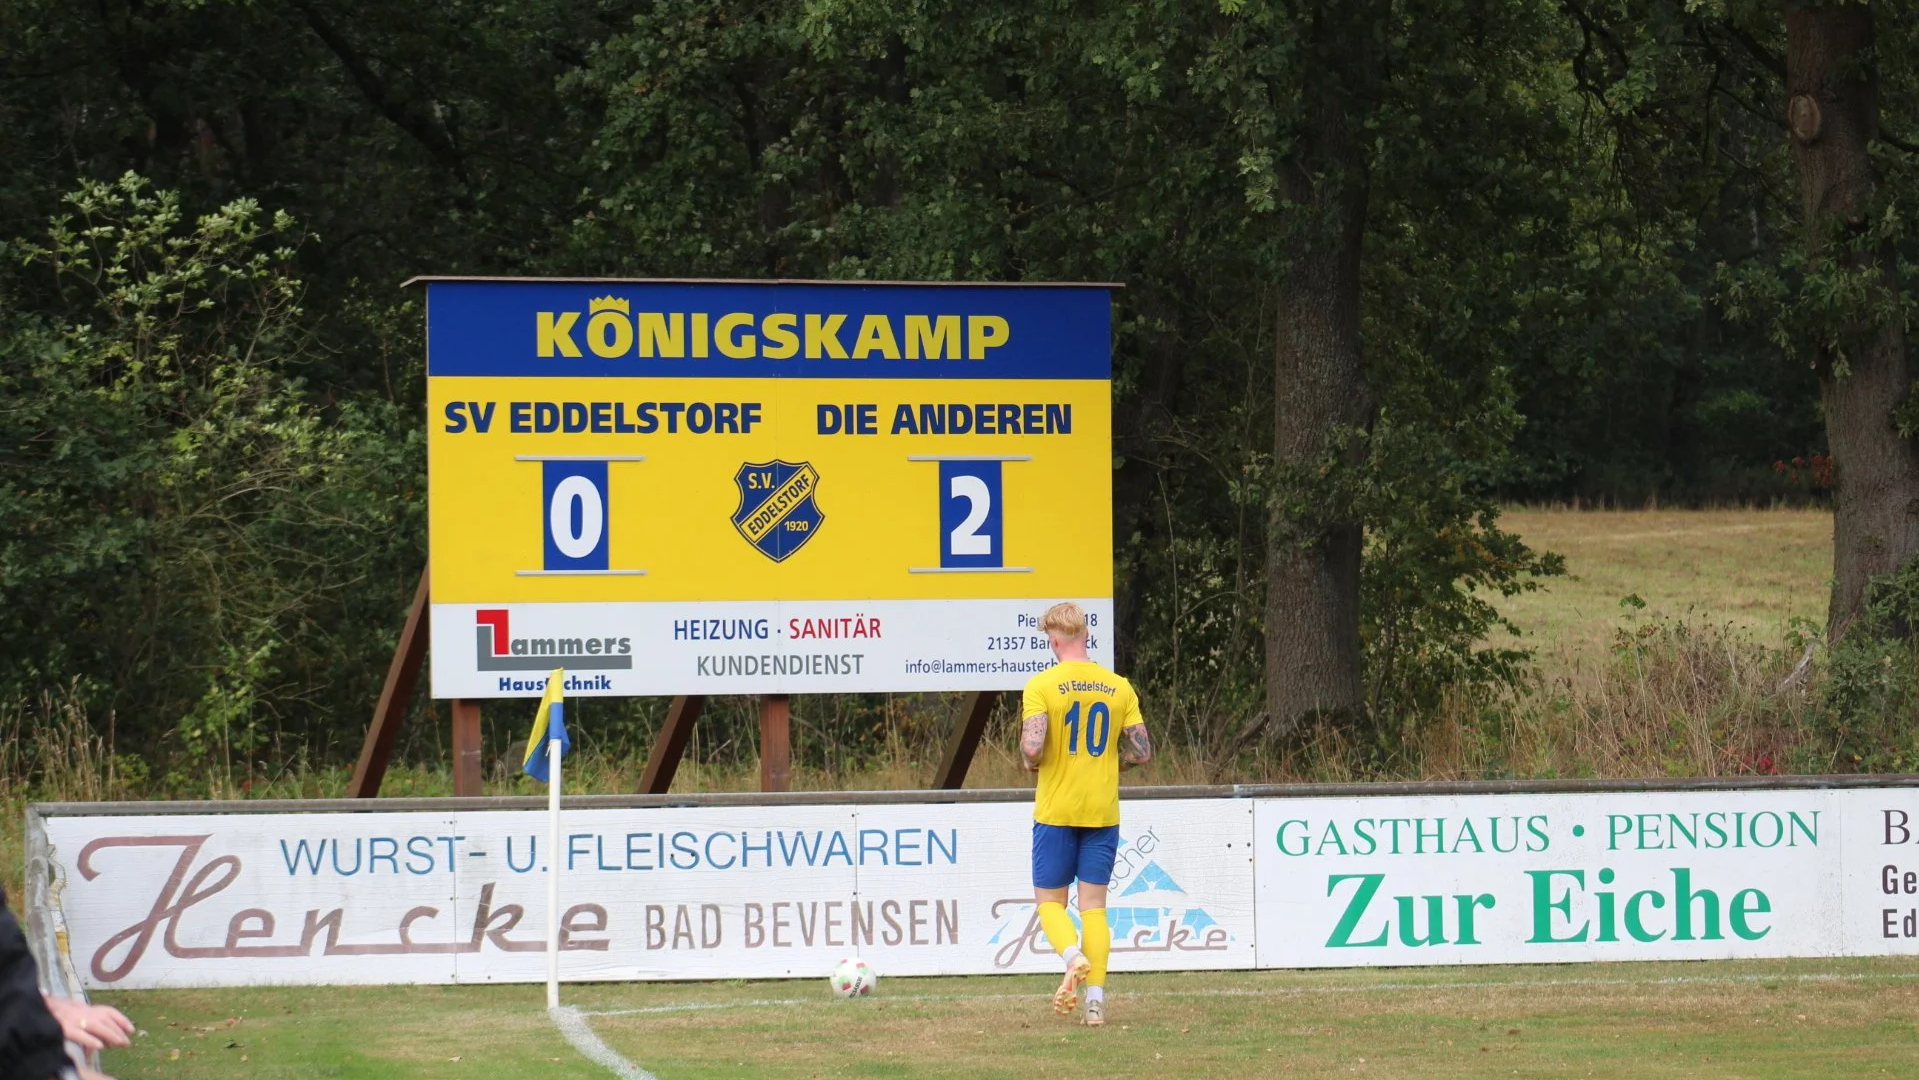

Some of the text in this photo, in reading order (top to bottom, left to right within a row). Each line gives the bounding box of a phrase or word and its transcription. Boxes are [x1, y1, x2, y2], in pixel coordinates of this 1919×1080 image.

[445, 402, 762, 434] SV EDDELSTORF
[817, 404, 1072, 435] DIE ANDEREN
[748, 472, 775, 489] S.V.
[550, 475, 603, 559] 0
[747, 474, 810, 535] EDDELSTORF
[950, 475, 991, 555] 2
[784, 521, 809, 532] 1920
[674, 613, 882, 640] HEIZUNG SANITÄR
[987, 637, 1026, 650] 21357
[499, 675, 612, 691] Hauschnik
[697, 654, 865, 676] KUNDENDIENST
[1058, 680, 1116, 697] SV Eddelstorf
[1064, 700, 1110, 757] 10
[1276, 810, 1821, 857] GASTHAUS PENSION
[1880, 809, 1919, 845] B
[279, 828, 957, 876] WURST- U. FLEISCHWAREN
[76, 833, 610, 982] Hencke
[645, 899, 959, 950] BAD BEVENSEN
[1325, 867, 1772, 948] Zur Eiche
[991, 897, 1228, 969] Hcke
